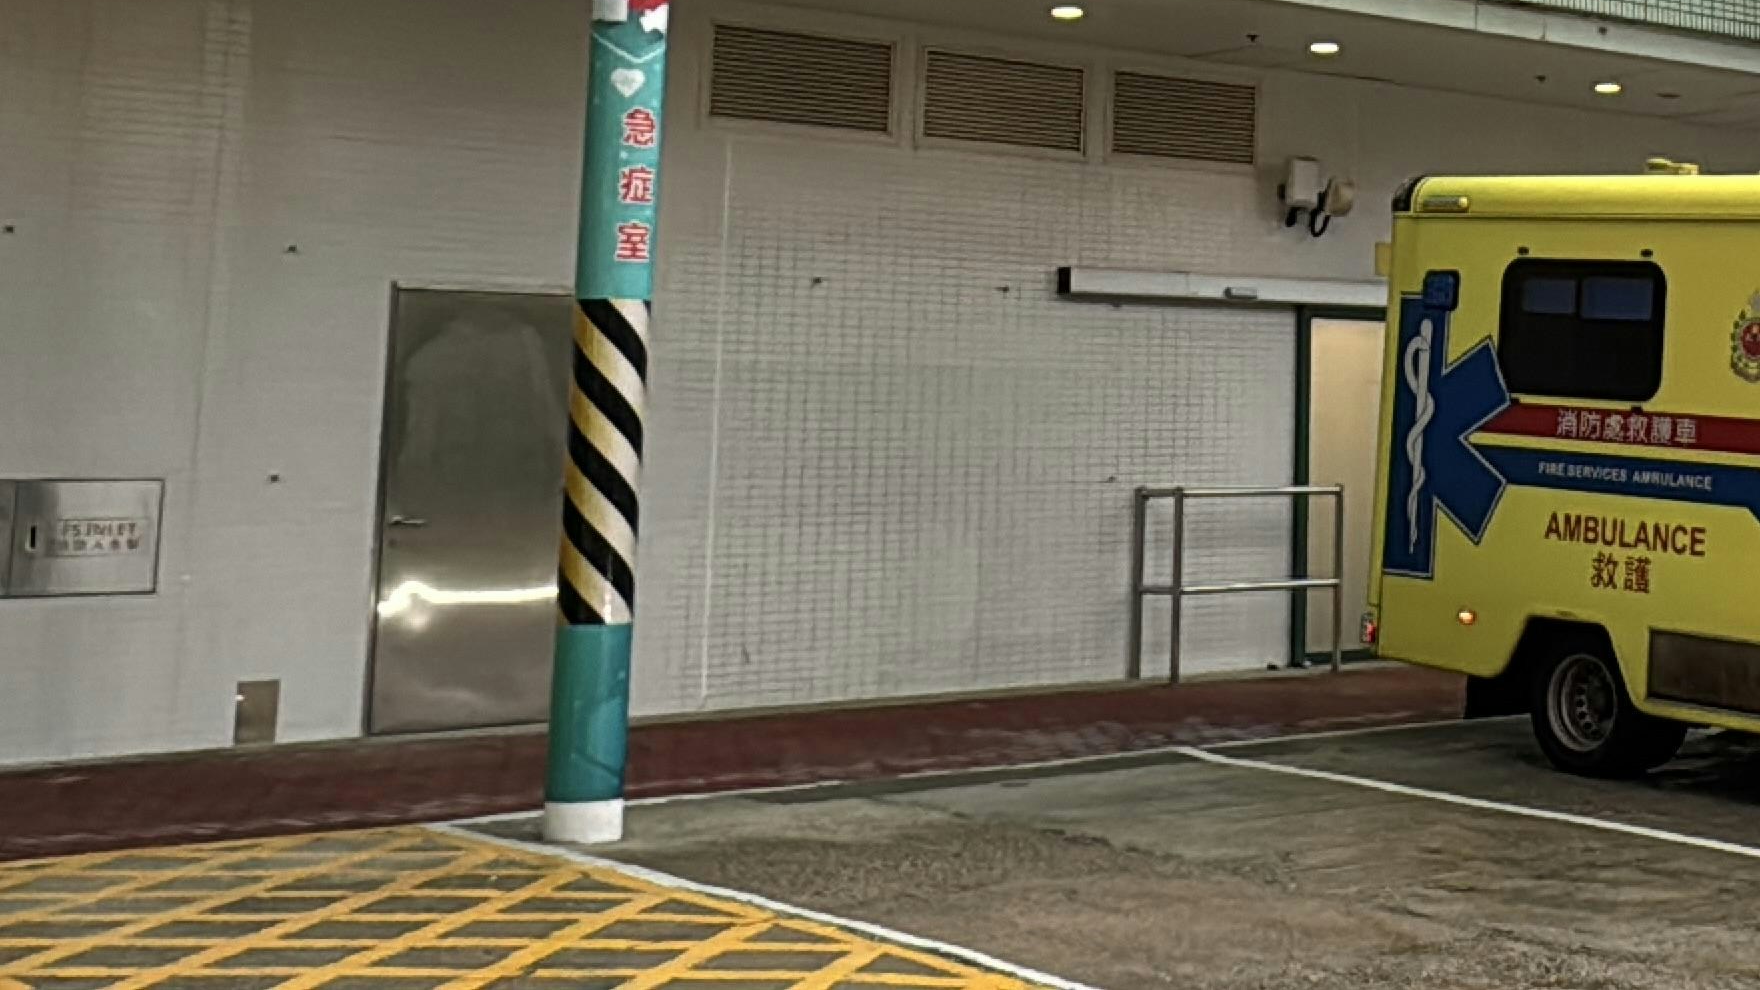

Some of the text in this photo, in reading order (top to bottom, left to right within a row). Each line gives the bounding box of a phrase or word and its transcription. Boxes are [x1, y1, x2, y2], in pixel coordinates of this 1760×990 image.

[614, 106, 657, 262] 急症室
[1556, 409, 1697, 445] 消防處救護車
[1538, 462, 1713, 491] FIRE SERVICES AMBULANCE
[1544, 510, 1707, 557] AMBULANCE
[1590, 551, 1652, 594] 救護
